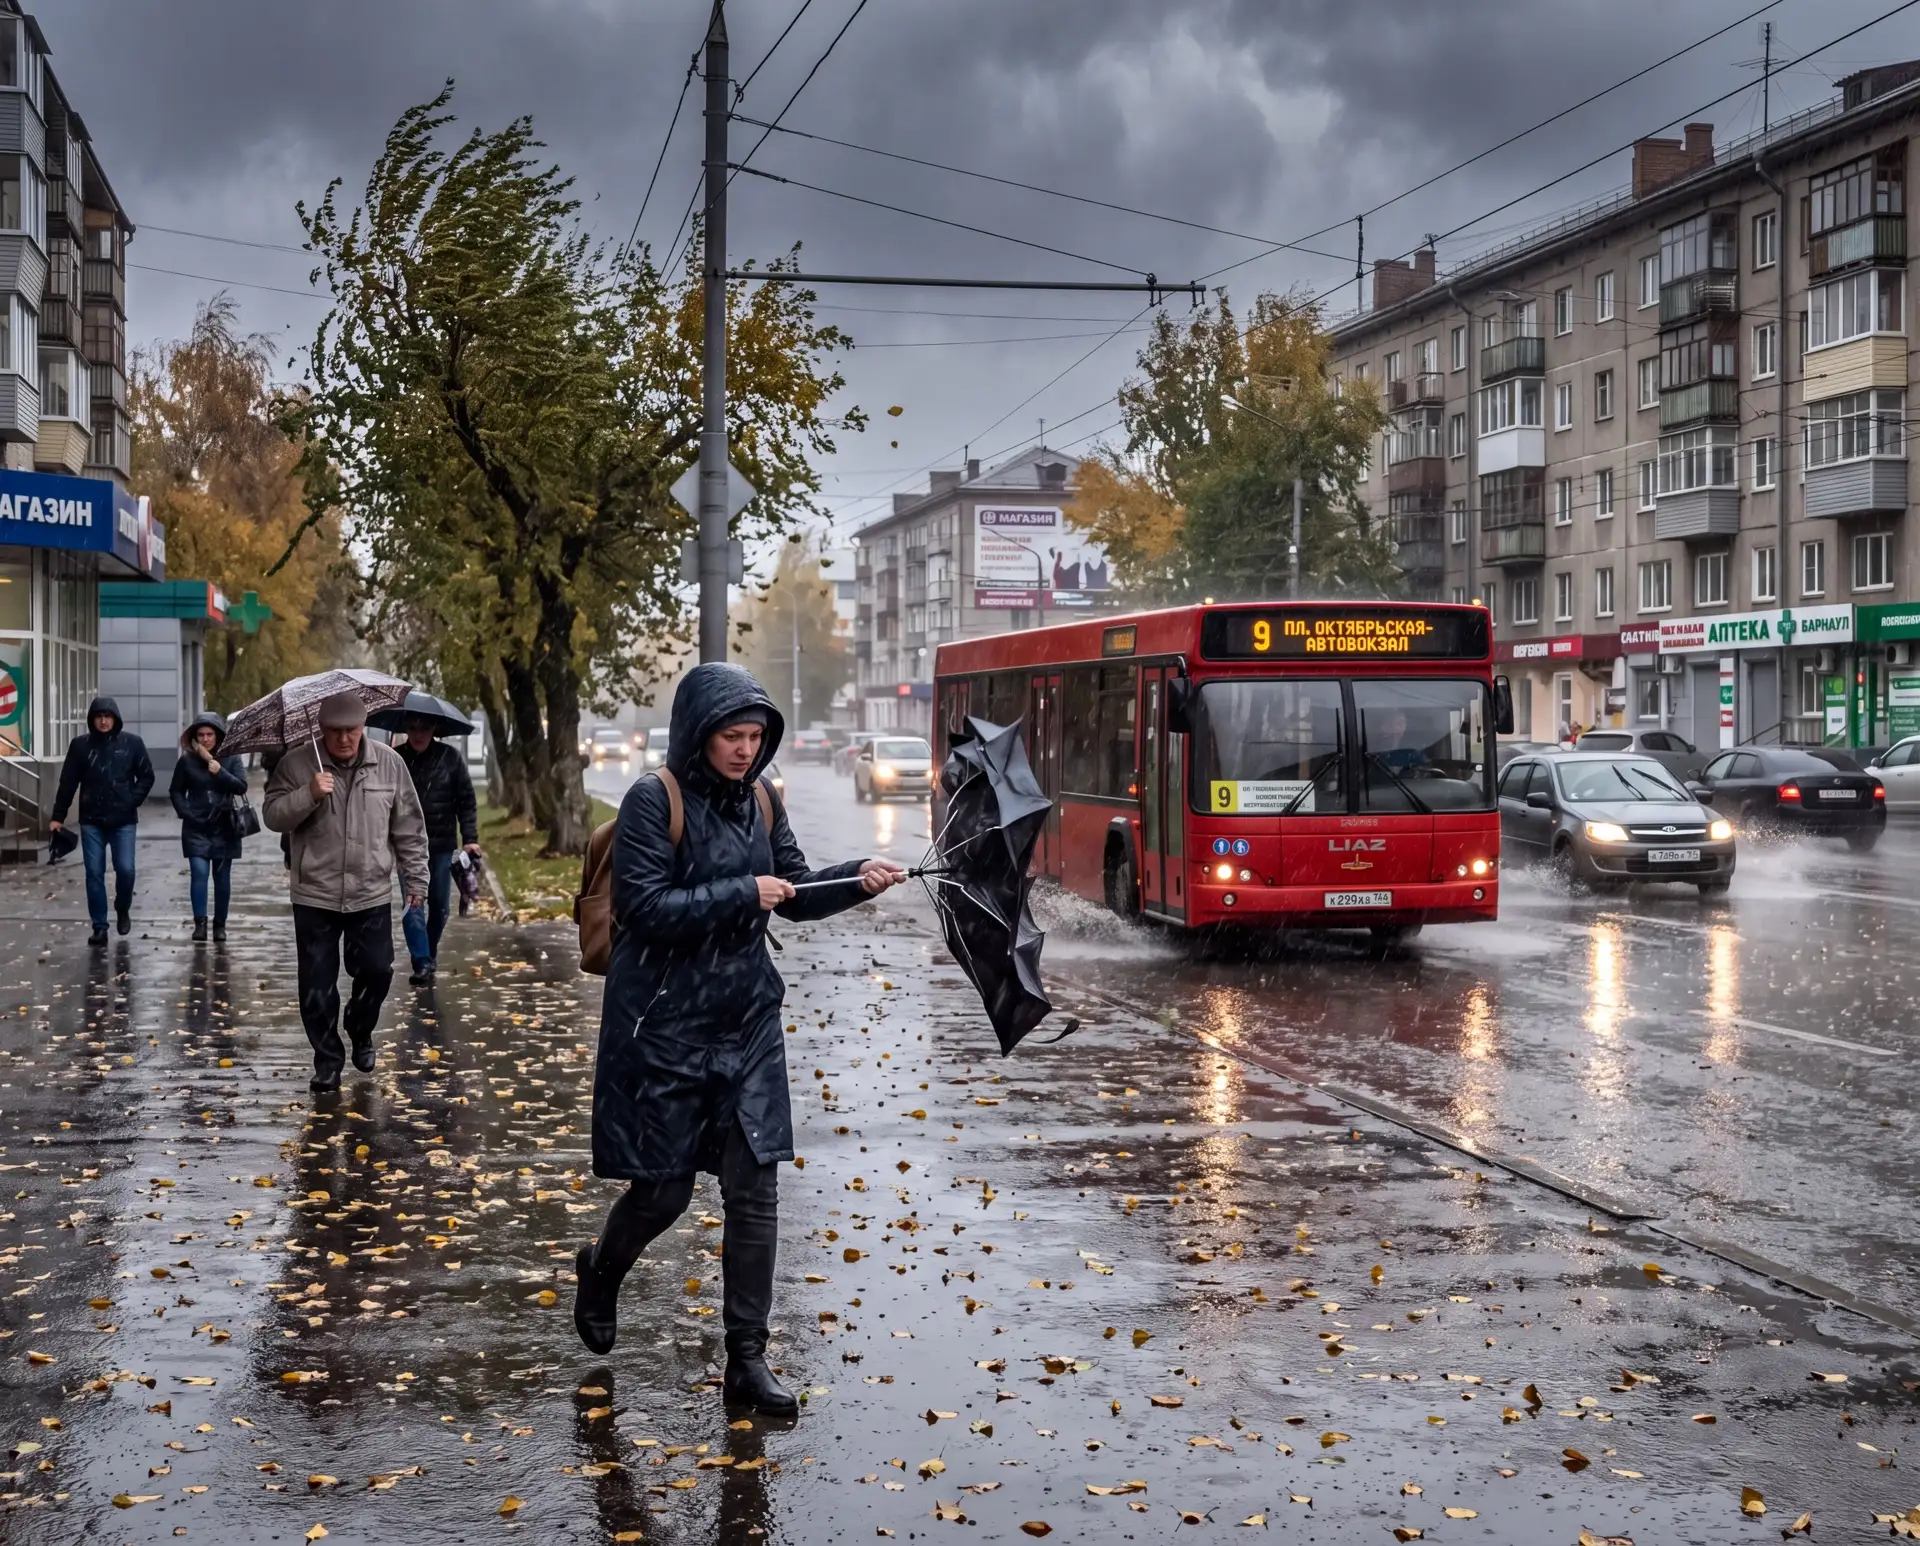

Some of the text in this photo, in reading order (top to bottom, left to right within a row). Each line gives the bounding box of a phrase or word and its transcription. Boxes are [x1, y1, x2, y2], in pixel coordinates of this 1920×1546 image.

[1253, 620, 1271, 651] 9
[1284, 620, 1311, 636] ПЛ.
[1708, 619, 1770, 643] АПТЕКА
[1801, 616, 1849, 633] БАРНАУЛ
[1306, 637, 1409, 652] АВТОВОКЗАЛ
[1218, 786, 1231, 808] 9
[1328, 839, 1387, 852] LIAZ
